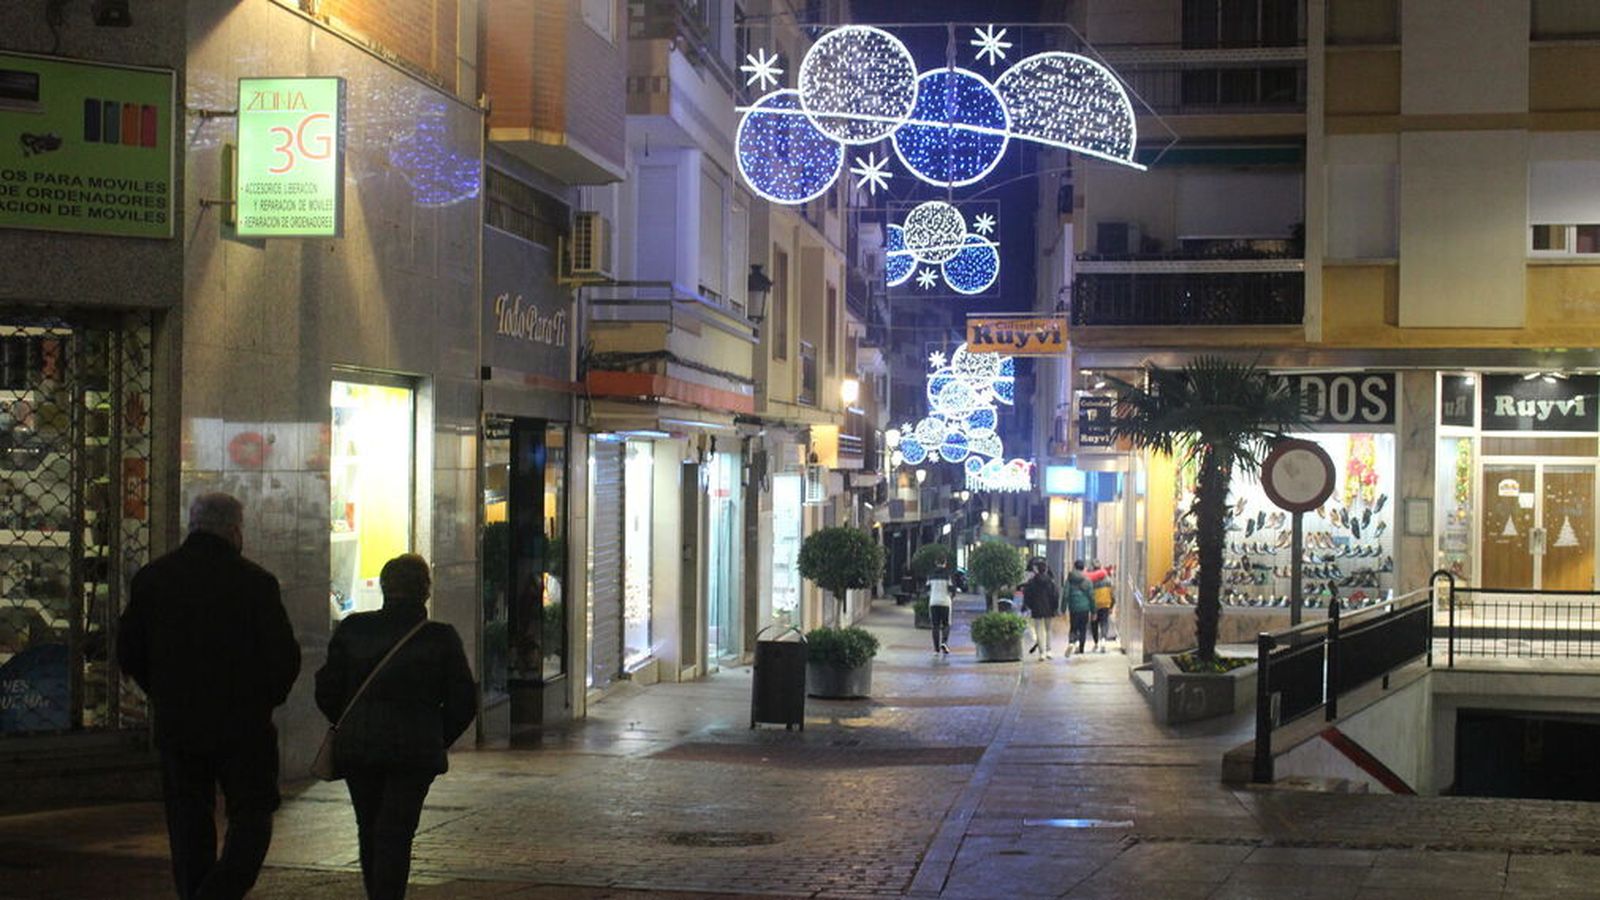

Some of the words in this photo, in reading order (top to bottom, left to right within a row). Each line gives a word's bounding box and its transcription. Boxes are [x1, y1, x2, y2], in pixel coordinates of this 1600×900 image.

[269, 113, 331, 174] 3G
[33, 172, 83, 187] PARA
[88, 177, 166, 194] MOVILES
[26, 187, 166, 209] ORDENADORES
[298, 199, 306, 211] DE
[58, 204, 81, 217] DE
[88, 207, 166, 225] MOVILES
[281, 216, 289, 228] DE
[973, 322, 1062, 349] Ruyvi
[1494, 394, 1586, 421] Ruyvi
